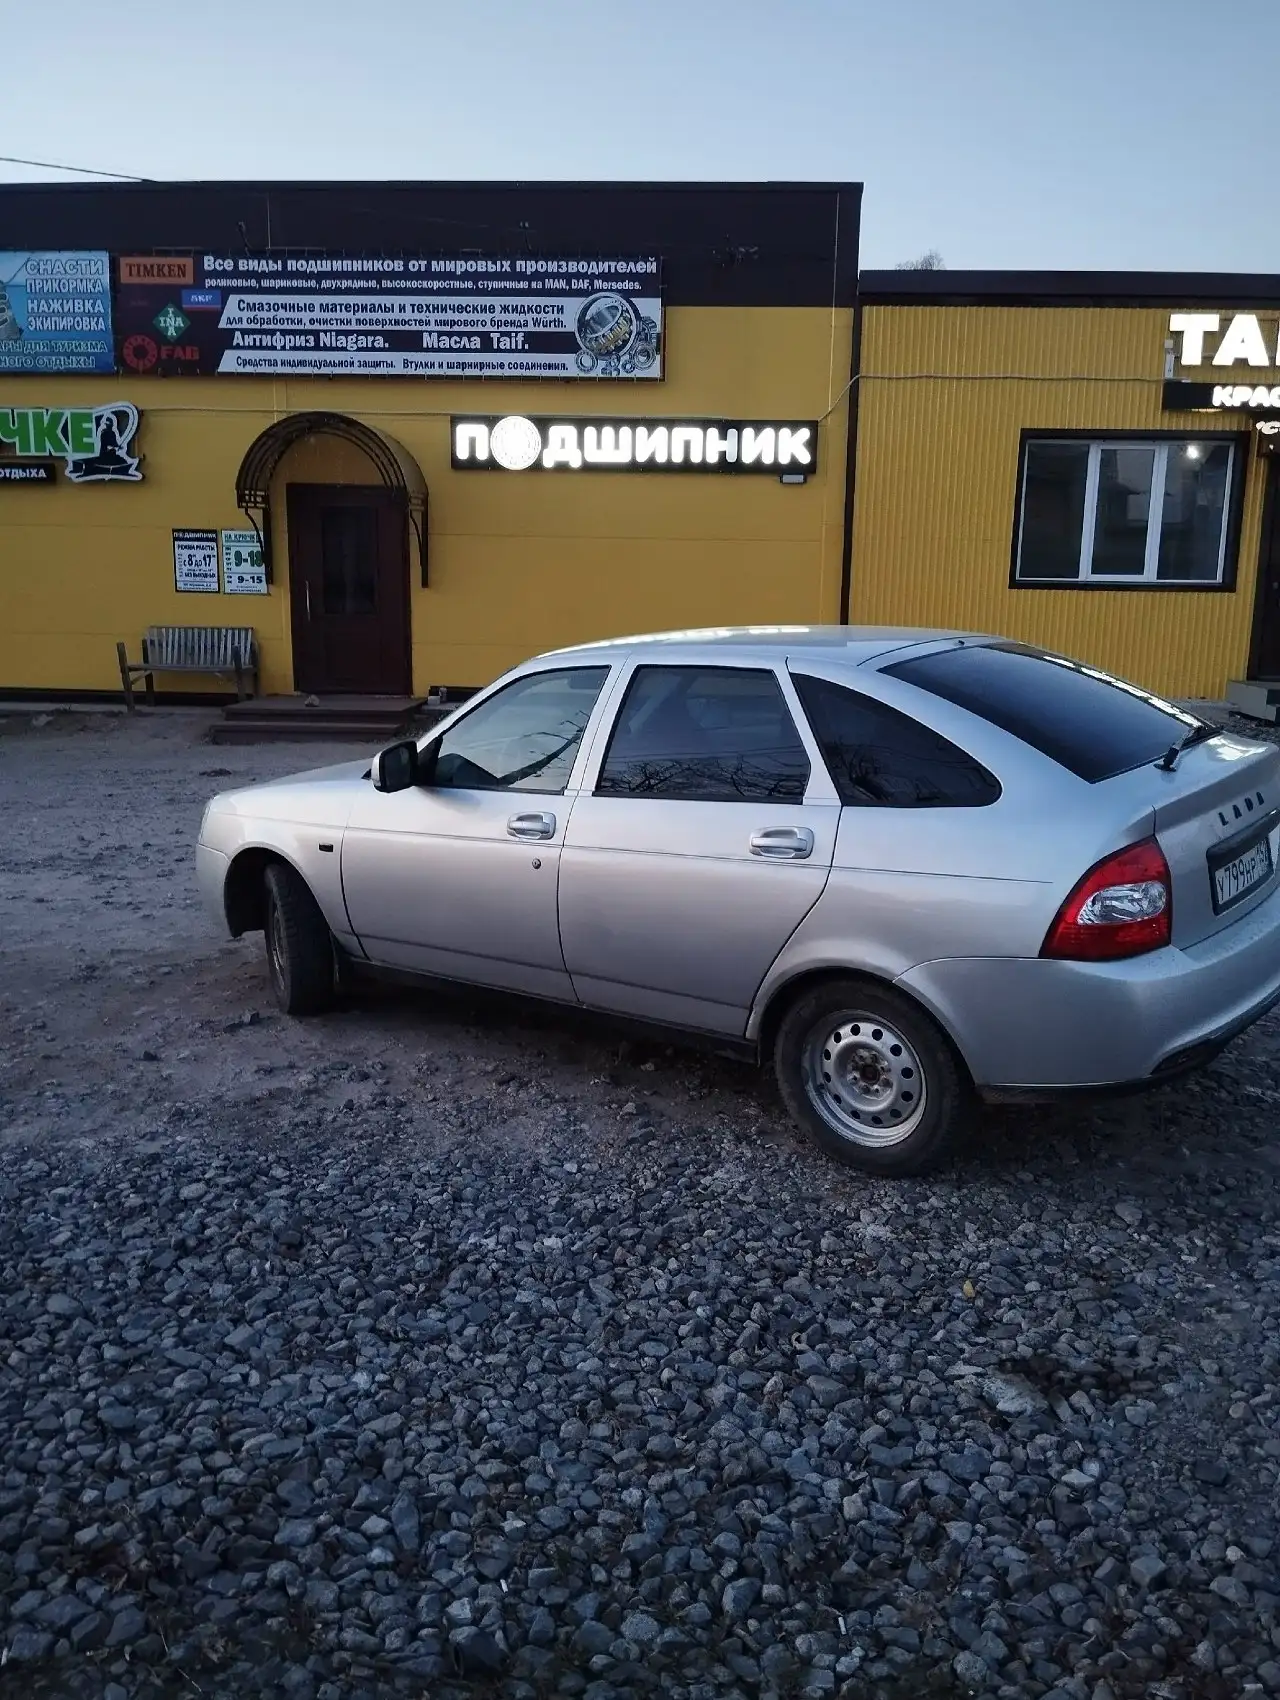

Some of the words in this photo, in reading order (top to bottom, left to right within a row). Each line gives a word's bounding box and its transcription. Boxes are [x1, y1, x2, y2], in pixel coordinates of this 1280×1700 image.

[25, 259, 104, 276] СНАСТИ
[126, 263, 187, 278] TIMKEN
[203, 255, 234, 271] Все
[238, 259, 282, 273] виды
[287, 259, 404, 273] подшипников
[408, 260, 427, 271] от
[431, 260, 511, 275] мировых
[516, 257, 658, 275] производителей
[26, 279, 104, 293] ПРИКОРМКА
[205, 278, 259, 289] роликовые,
[261, 278, 319, 289] шариковые,
[320, 279, 380, 290] двухрядные,
[381, 279, 476, 290] высокоскоростные,
[478, 280, 529, 290] ступичные
[531, 281, 543, 289] на
[544, 279, 569, 291] MAN,
[571, 279, 592, 291] DAF,
[594, 280, 642, 290] Mersedes.
[27, 299, 105, 314] НАЖИВКА
[237, 299, 316, 314] Смазочные
[319, 302, 395, 316] материалы
[398, 303, 407, 313] и
[410, 302, 496, 314] технические
[499, 304, 565, 316] жидкости
[28, 316, 106, 331] ЭКИПИРОВКА
[226, 316, 243, 326] для
[246, 314, 307, 328] обработки,
[309, 317, 352, 326] очистки
[355, 315, 431, 328] поверхностей
[434, 318, 487, 329] мирового
[490, 316, 529, 329] бренда
[52, 341, 108, 353] ТУРИЗМА
[232, 331, 315, 350] Антифриз
[319, 332, 389, 351] Niagara.
[422, 332, 481, 349] Масла
[490, 332, 529, 350] Taif.
[1169, 313, 1280, 366] ТА
[236, 356, 278, 369] Средства
[280, 356, 355, 370] индивидуальной
[357, 358, 396, 370] защиты.
[403, 359, 436, 371] Втулки
[438, 361, 444, 370] и
[446, 361, 506, 372] шарнирные
[507, 361, 569, 372] соединения.
[455, 416, 811, 470] ПОДШИПНИК
[237, 575, 263, 584] 9-15
[1219, 791, 1265, 826] LADA
